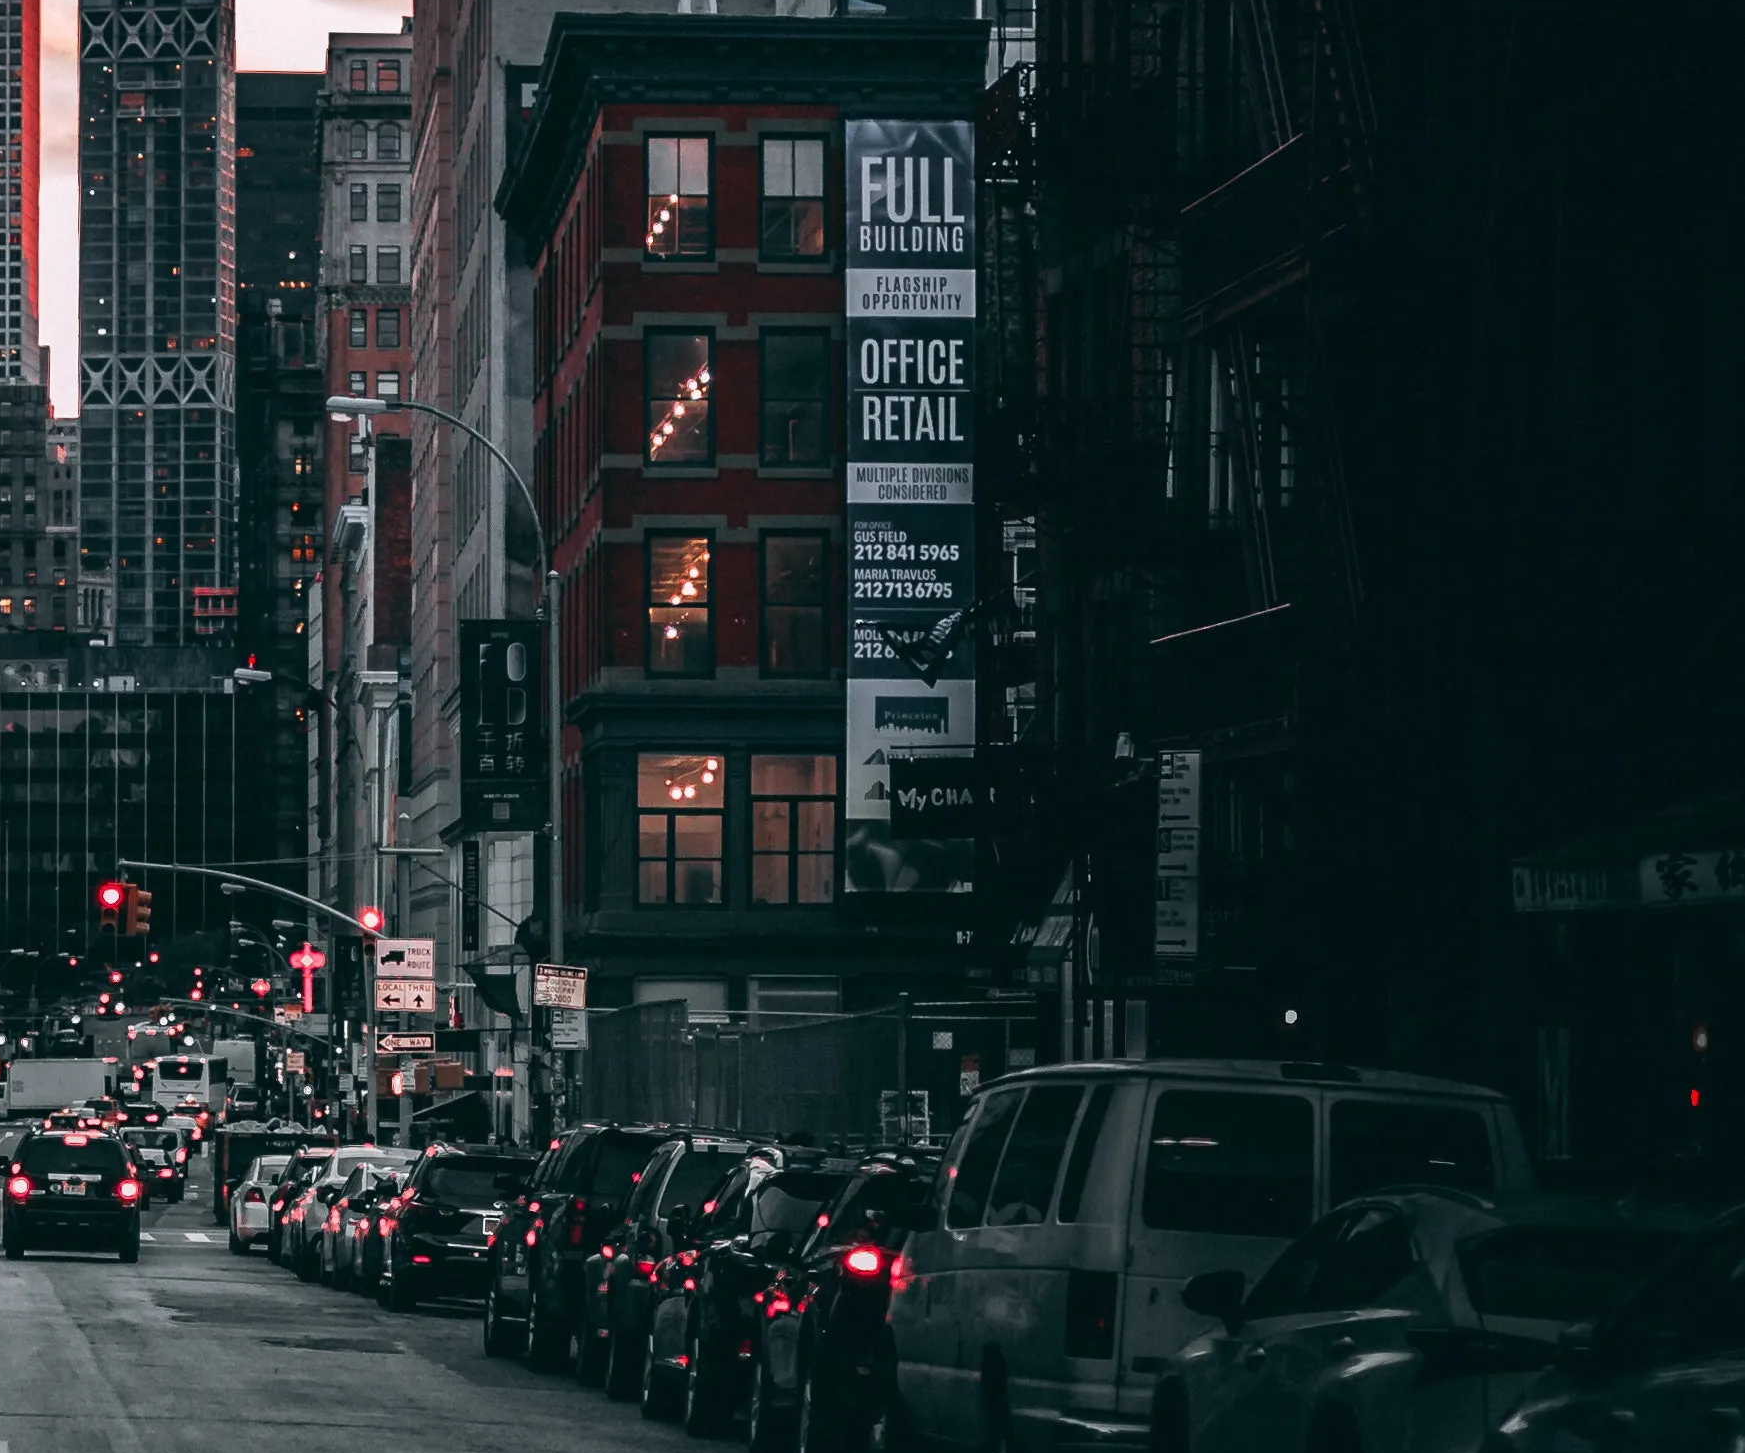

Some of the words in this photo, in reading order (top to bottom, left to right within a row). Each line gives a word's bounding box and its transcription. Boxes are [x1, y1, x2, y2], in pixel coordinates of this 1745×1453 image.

[860, 156, 965, 223] FULL
[859, 225, 964, 253] BUILDING
[876, 275, 947, 294] FLAGSHIP
[862, 293, 962, 310] OPPORTUNITY
[860, 338, 964, 385] OFFICE
[862, 395, 964, 442] RETAIL
[856, 467, 908, 483] MULTIPLE
[912, 467, 969, 484] DIVISIONS
[878, 484, 948, 500] CONSIDERED
[854, 531, 876, 543] GUS
[878, 531, 907, 543] FIELD
[854, 544, 883, 561] 212
[886, 544, 916, 561] 841
[919, 544, 960, 561] 5965
[854, 569, 889, 581] MARIA
[890, 569, 936, 581] TRAVLOS
[854, 582, 883, 598] 212
[885, 582, 913, 598] 713
[915, 582, 953, 598] 6795
[854, 644, 882, 659] 212
[884, 711, 938, 720] Princeton
[407, 948, 431, 956] TRUCK
[407, 961, 430, 969] ROUTE
[385, 1038, 401, 1046] ONE
[409, 1038, 427, 1046] WAY
